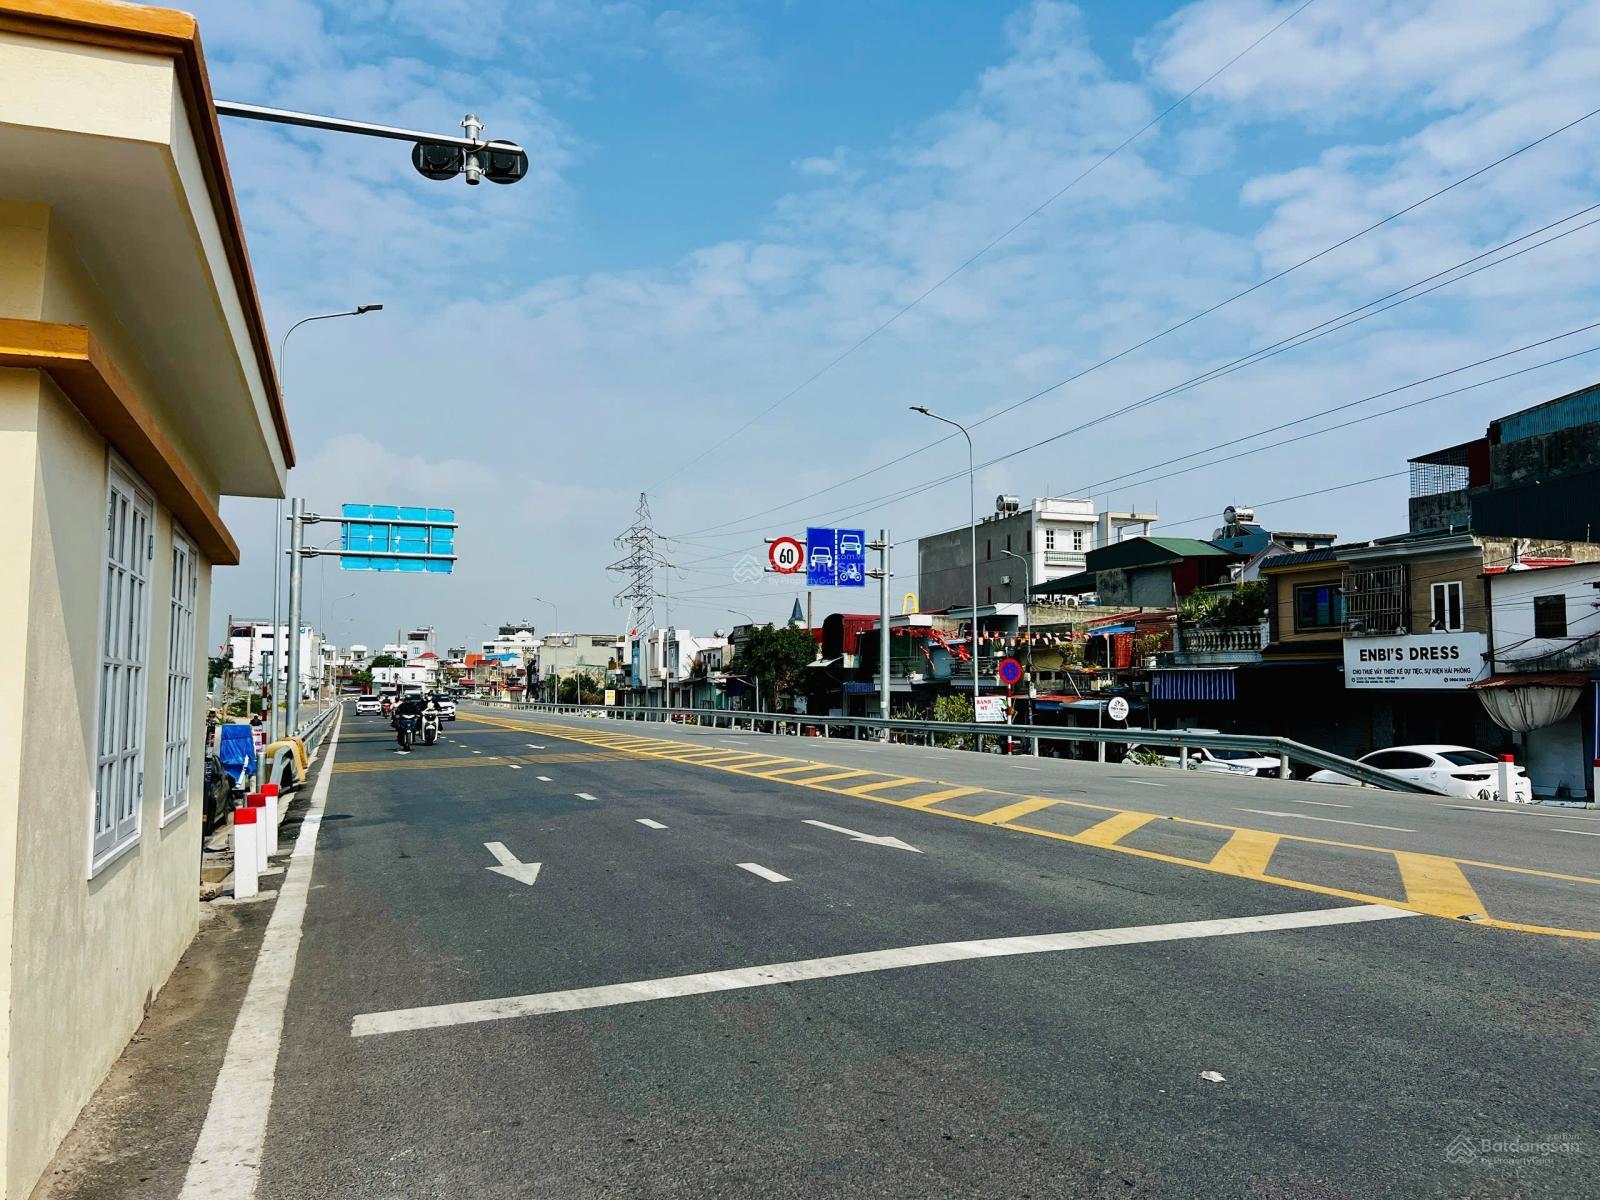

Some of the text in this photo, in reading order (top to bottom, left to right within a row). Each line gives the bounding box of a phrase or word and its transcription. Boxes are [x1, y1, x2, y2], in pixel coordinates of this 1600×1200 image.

[779, 549, 794, 564] 60
[1360, 646, 1459, 661] ENBI'S DRESS
